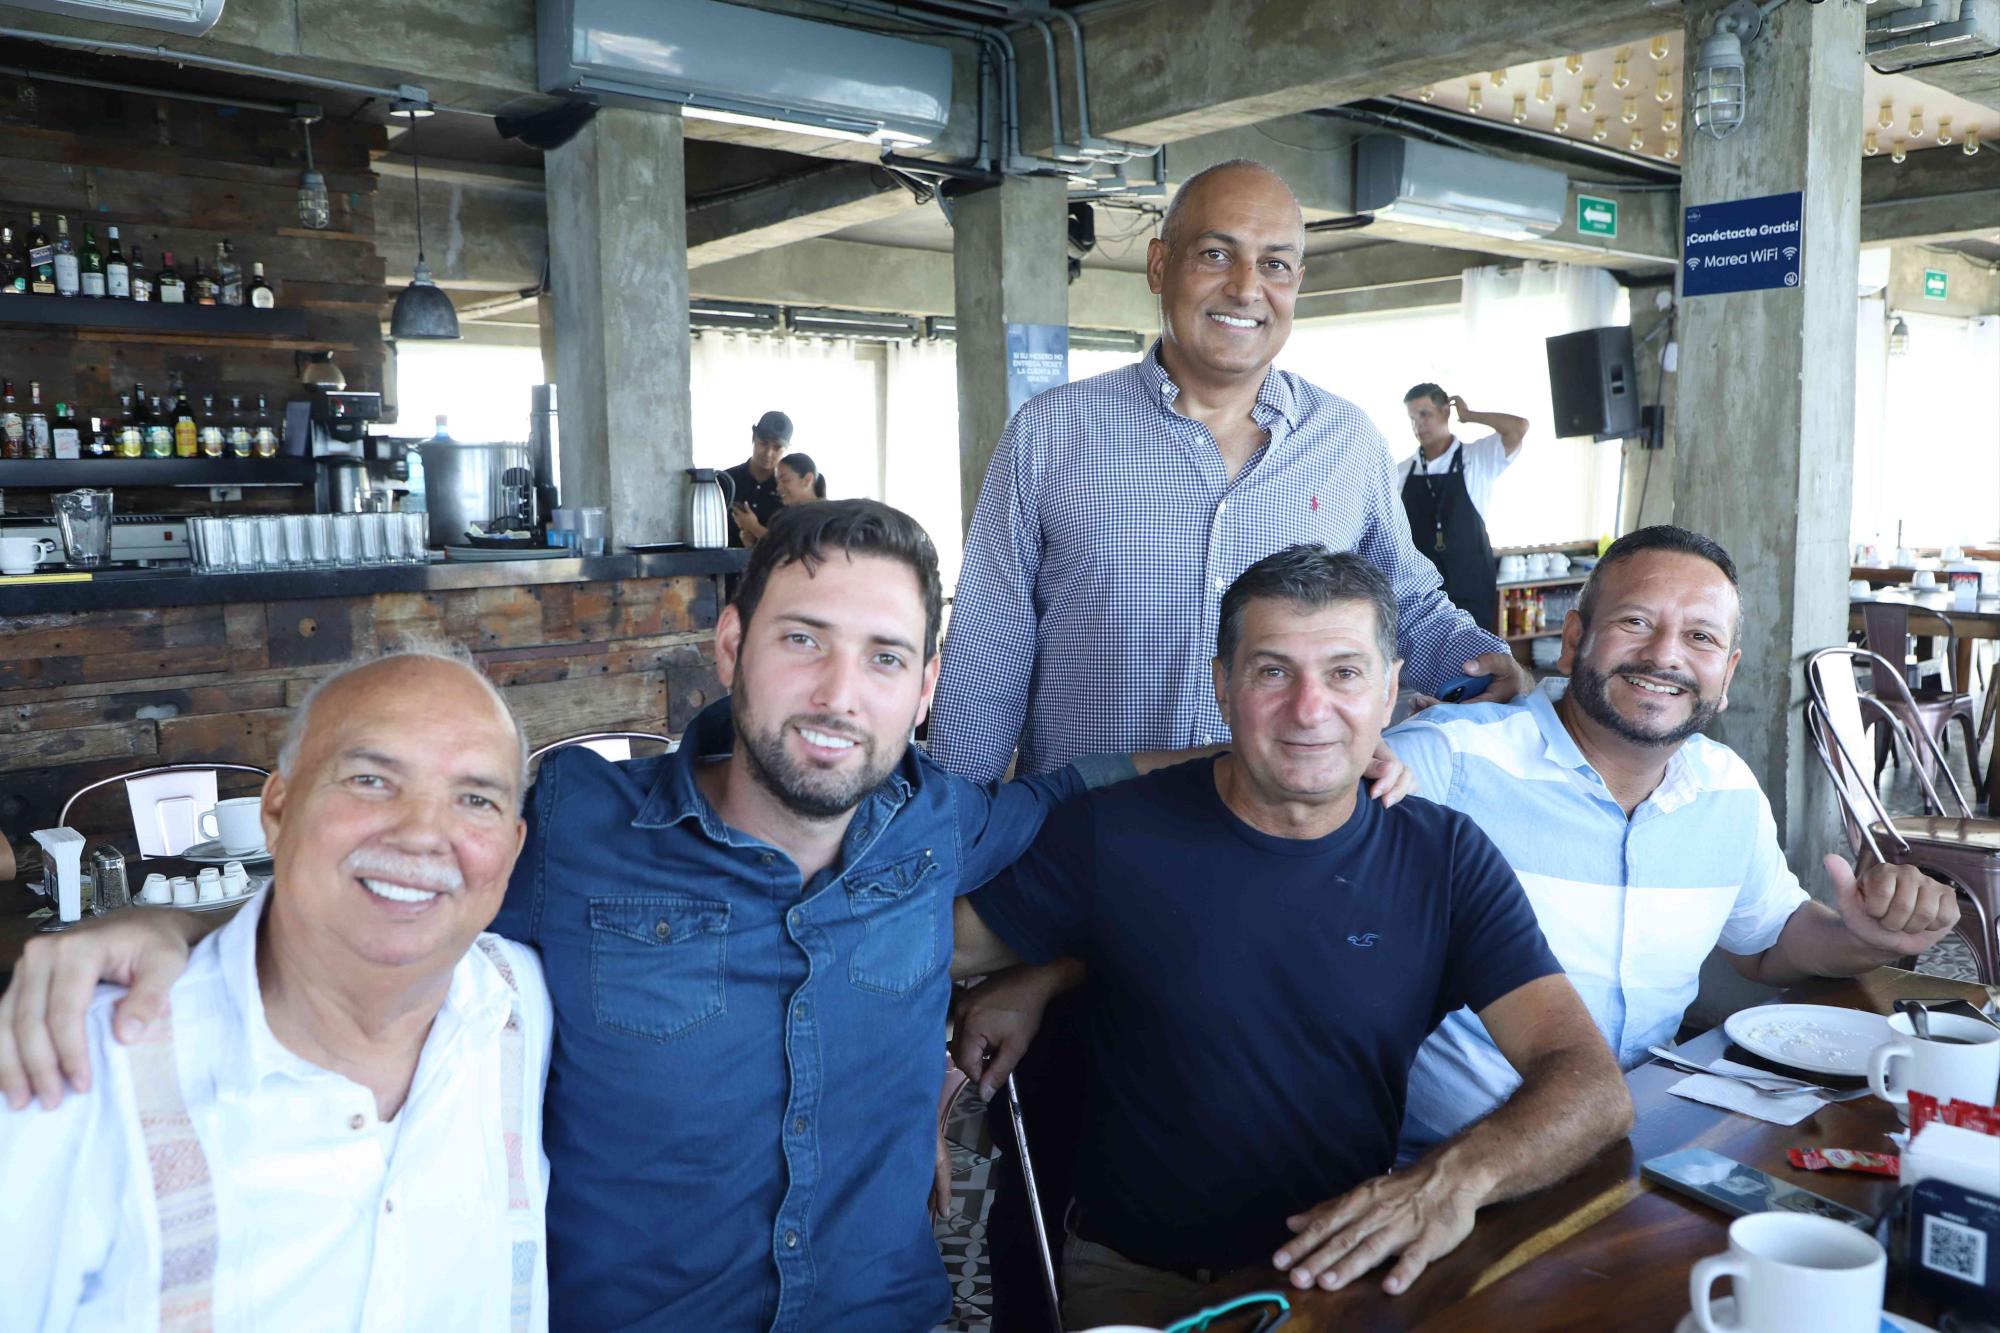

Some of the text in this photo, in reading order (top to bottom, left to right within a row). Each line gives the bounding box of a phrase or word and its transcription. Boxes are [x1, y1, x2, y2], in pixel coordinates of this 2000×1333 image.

[1759, 220, 1799, 235] Gratis!
[1704, 247, 1778, 268] Marea WiFi
